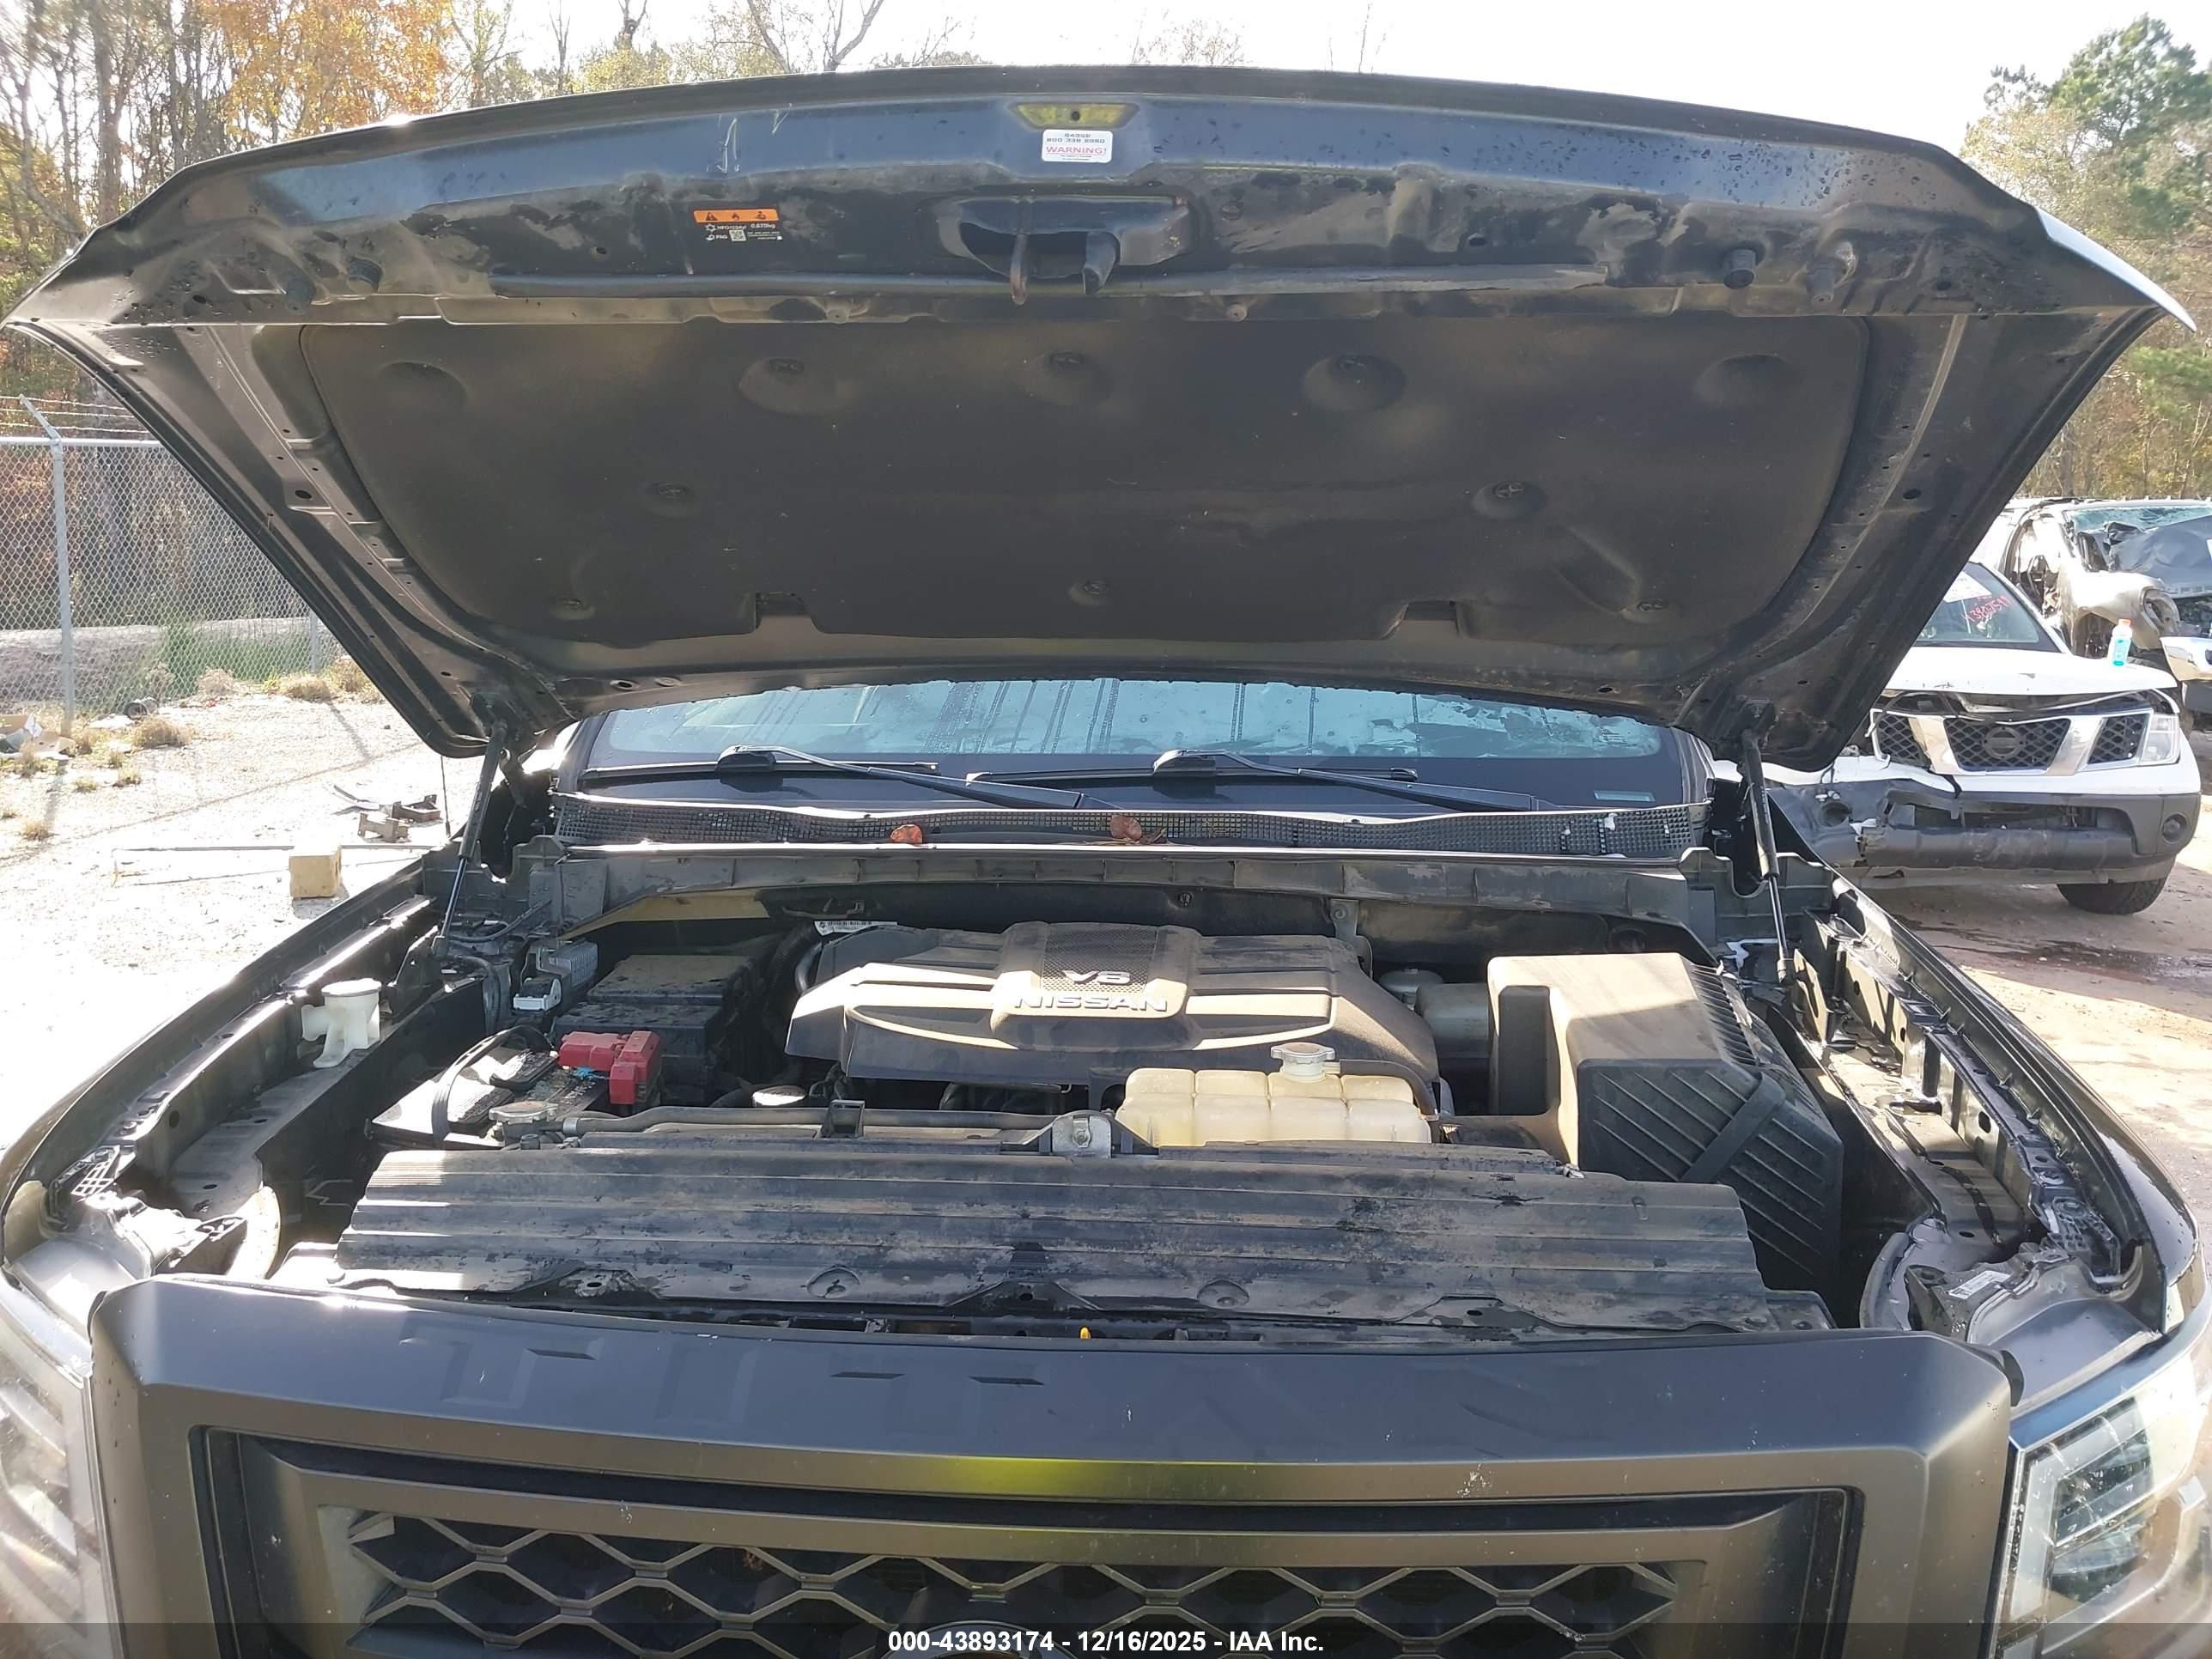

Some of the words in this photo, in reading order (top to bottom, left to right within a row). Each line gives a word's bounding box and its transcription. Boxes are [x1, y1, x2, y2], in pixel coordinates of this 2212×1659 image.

[1046, 146, 1107, 155] WARNING!
[1061, 969, 1133, 985] V8
[1013, 994, 1169, 1012] NISSAN
